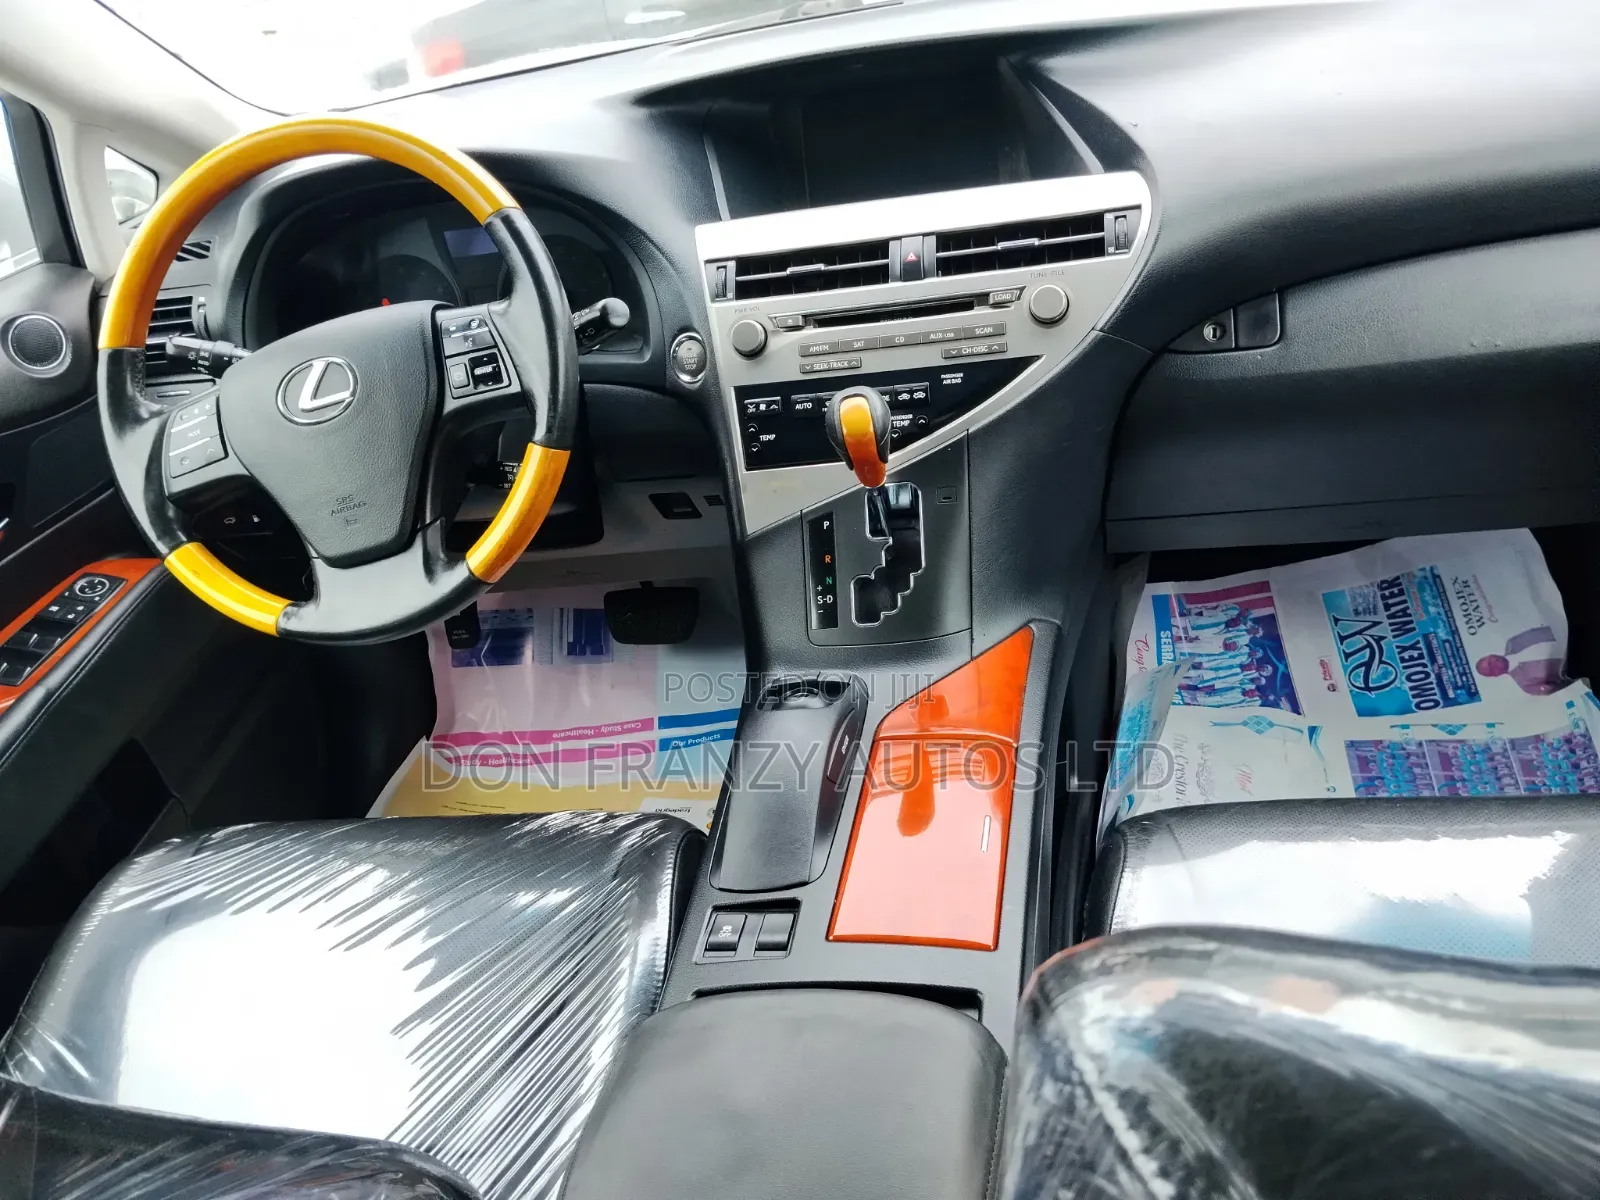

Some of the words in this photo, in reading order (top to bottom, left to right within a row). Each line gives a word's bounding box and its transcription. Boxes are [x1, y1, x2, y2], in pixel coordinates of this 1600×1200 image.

[975, 326, 994, 335] SCAN
[795, 402, 812, 410] AUTO
[759, 434, 776, 442] TEMP
[824, 521, 830, 530] P
[825, 555, 832, 563] R
[826, 576, 832, 584] N
[1377, 574, 1417, 640] WATER
[1450, 576, 1478, 636] OMOJEX
[1461, 579, 1486, 630] WATER
[1395, 639, 1442, 712] OMOJEX
[600, 724, 622, 734] Study
[622, 722, 642, 730] Case
[552, 727, 594, 738] Healthcare
[688, 732, 720, 745] Products
